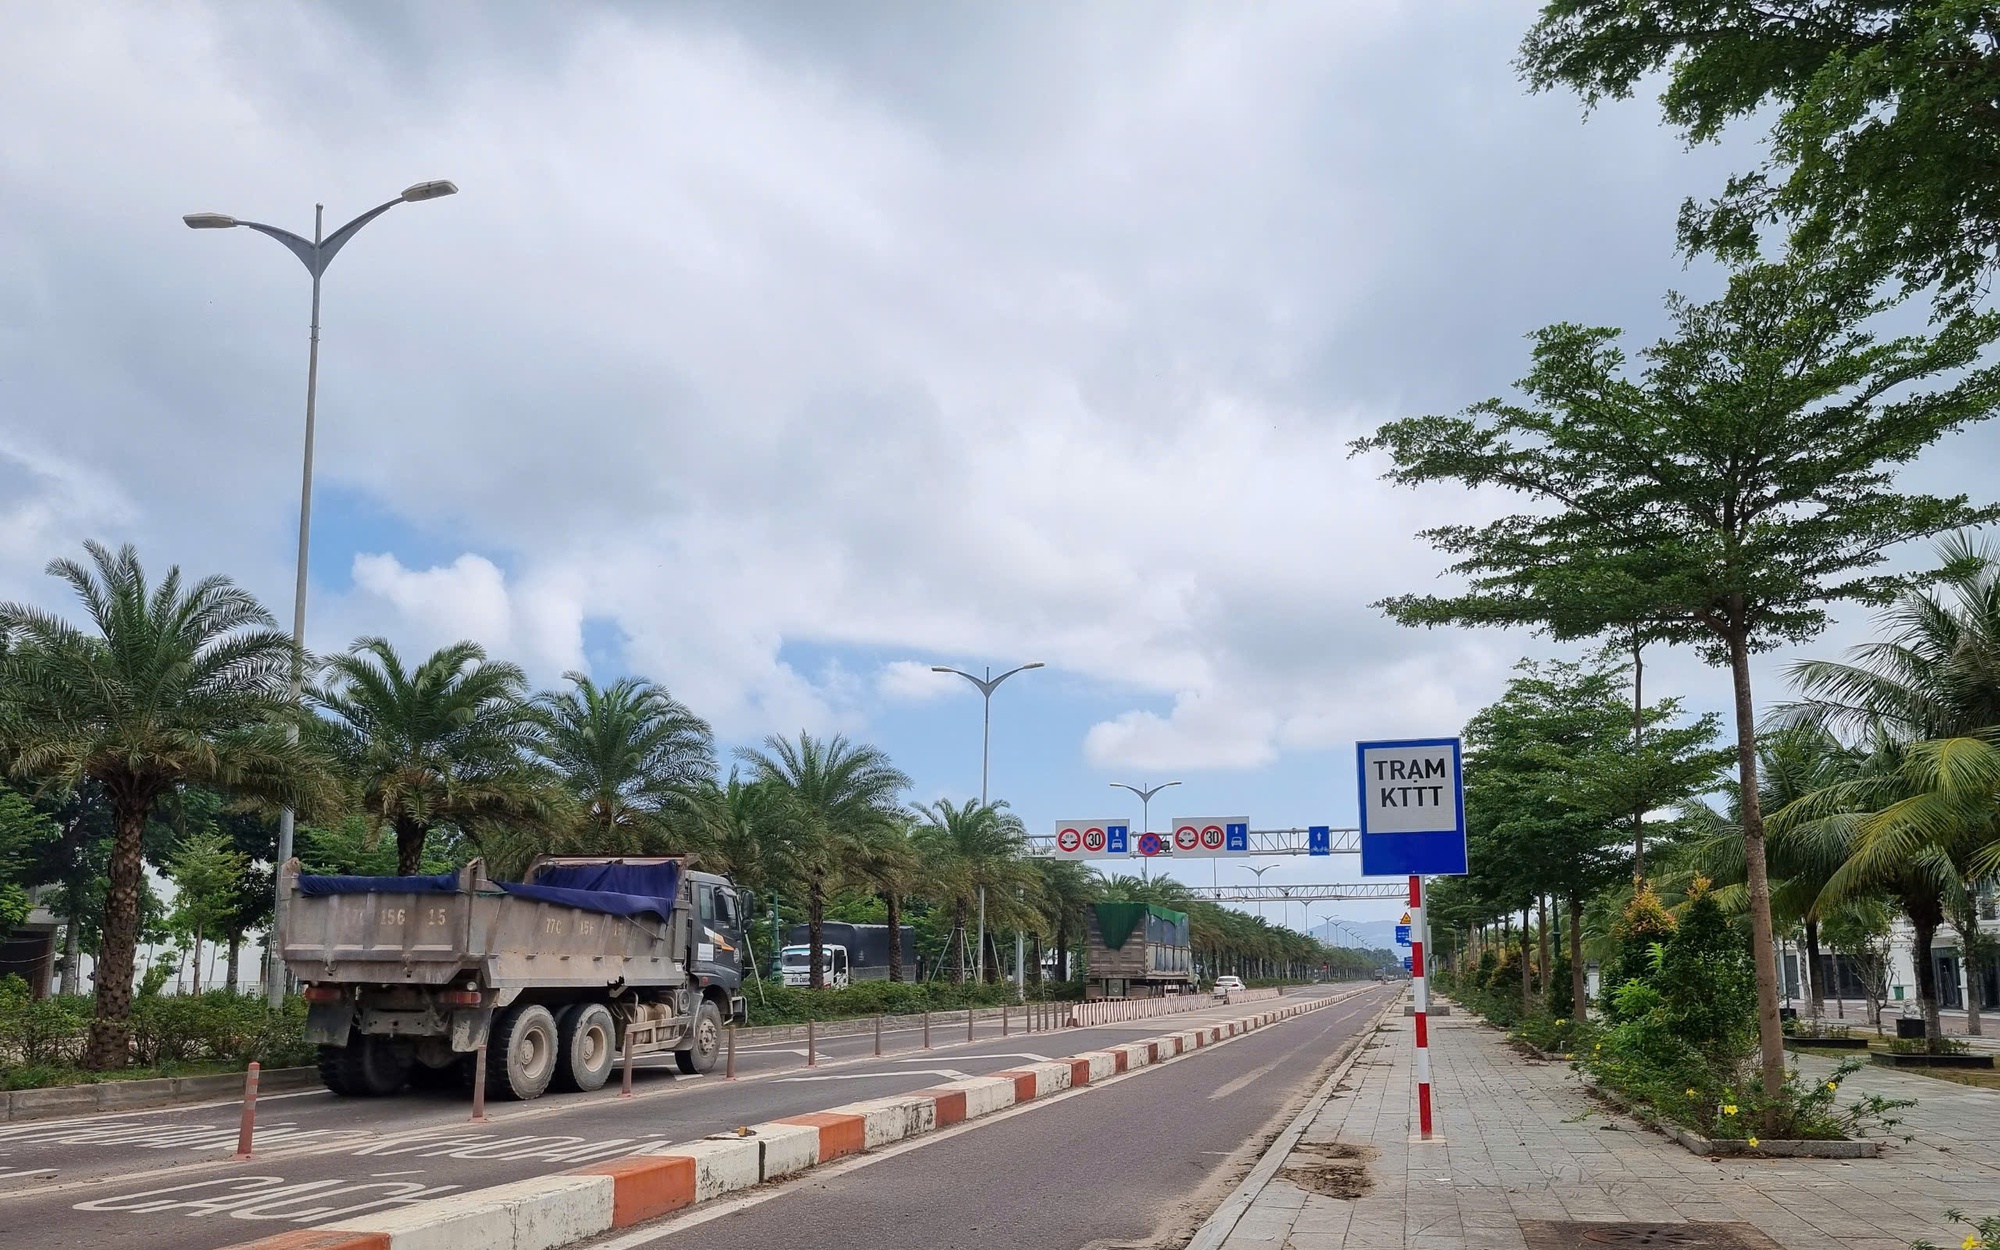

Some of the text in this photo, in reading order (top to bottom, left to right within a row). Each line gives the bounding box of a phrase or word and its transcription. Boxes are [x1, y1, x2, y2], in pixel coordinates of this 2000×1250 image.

[1381, 785, 1443, 808] KTTT
[1088, 833, 1101, 847] 30
[1206, 831, 1219, 844] 30
[381, 908, 406, 926] 156
[428, 908, 446, 926] 15
[546, 917, 562, 935] 77C
